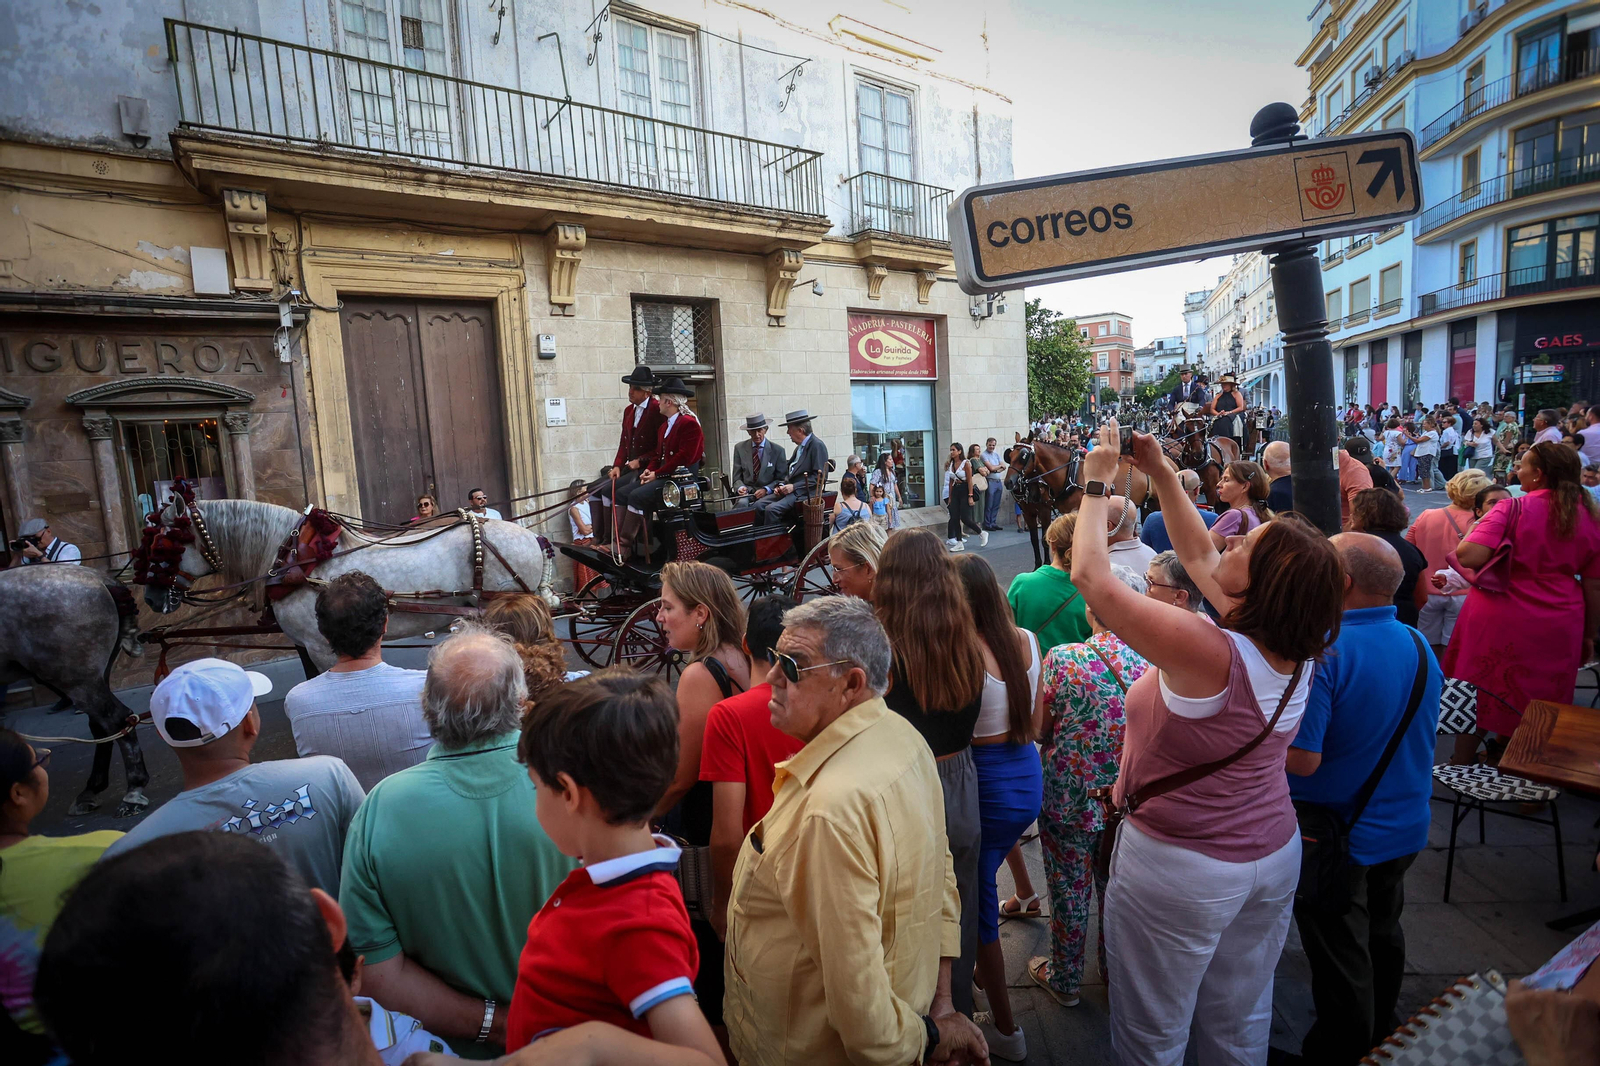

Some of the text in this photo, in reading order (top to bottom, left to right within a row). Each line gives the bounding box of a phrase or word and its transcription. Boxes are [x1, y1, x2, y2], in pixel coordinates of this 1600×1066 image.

[986, 202, 1133, 248] correos
[1534, 334, 1582, 348] GAES
[870, 345, 912, 354] La Guinda
